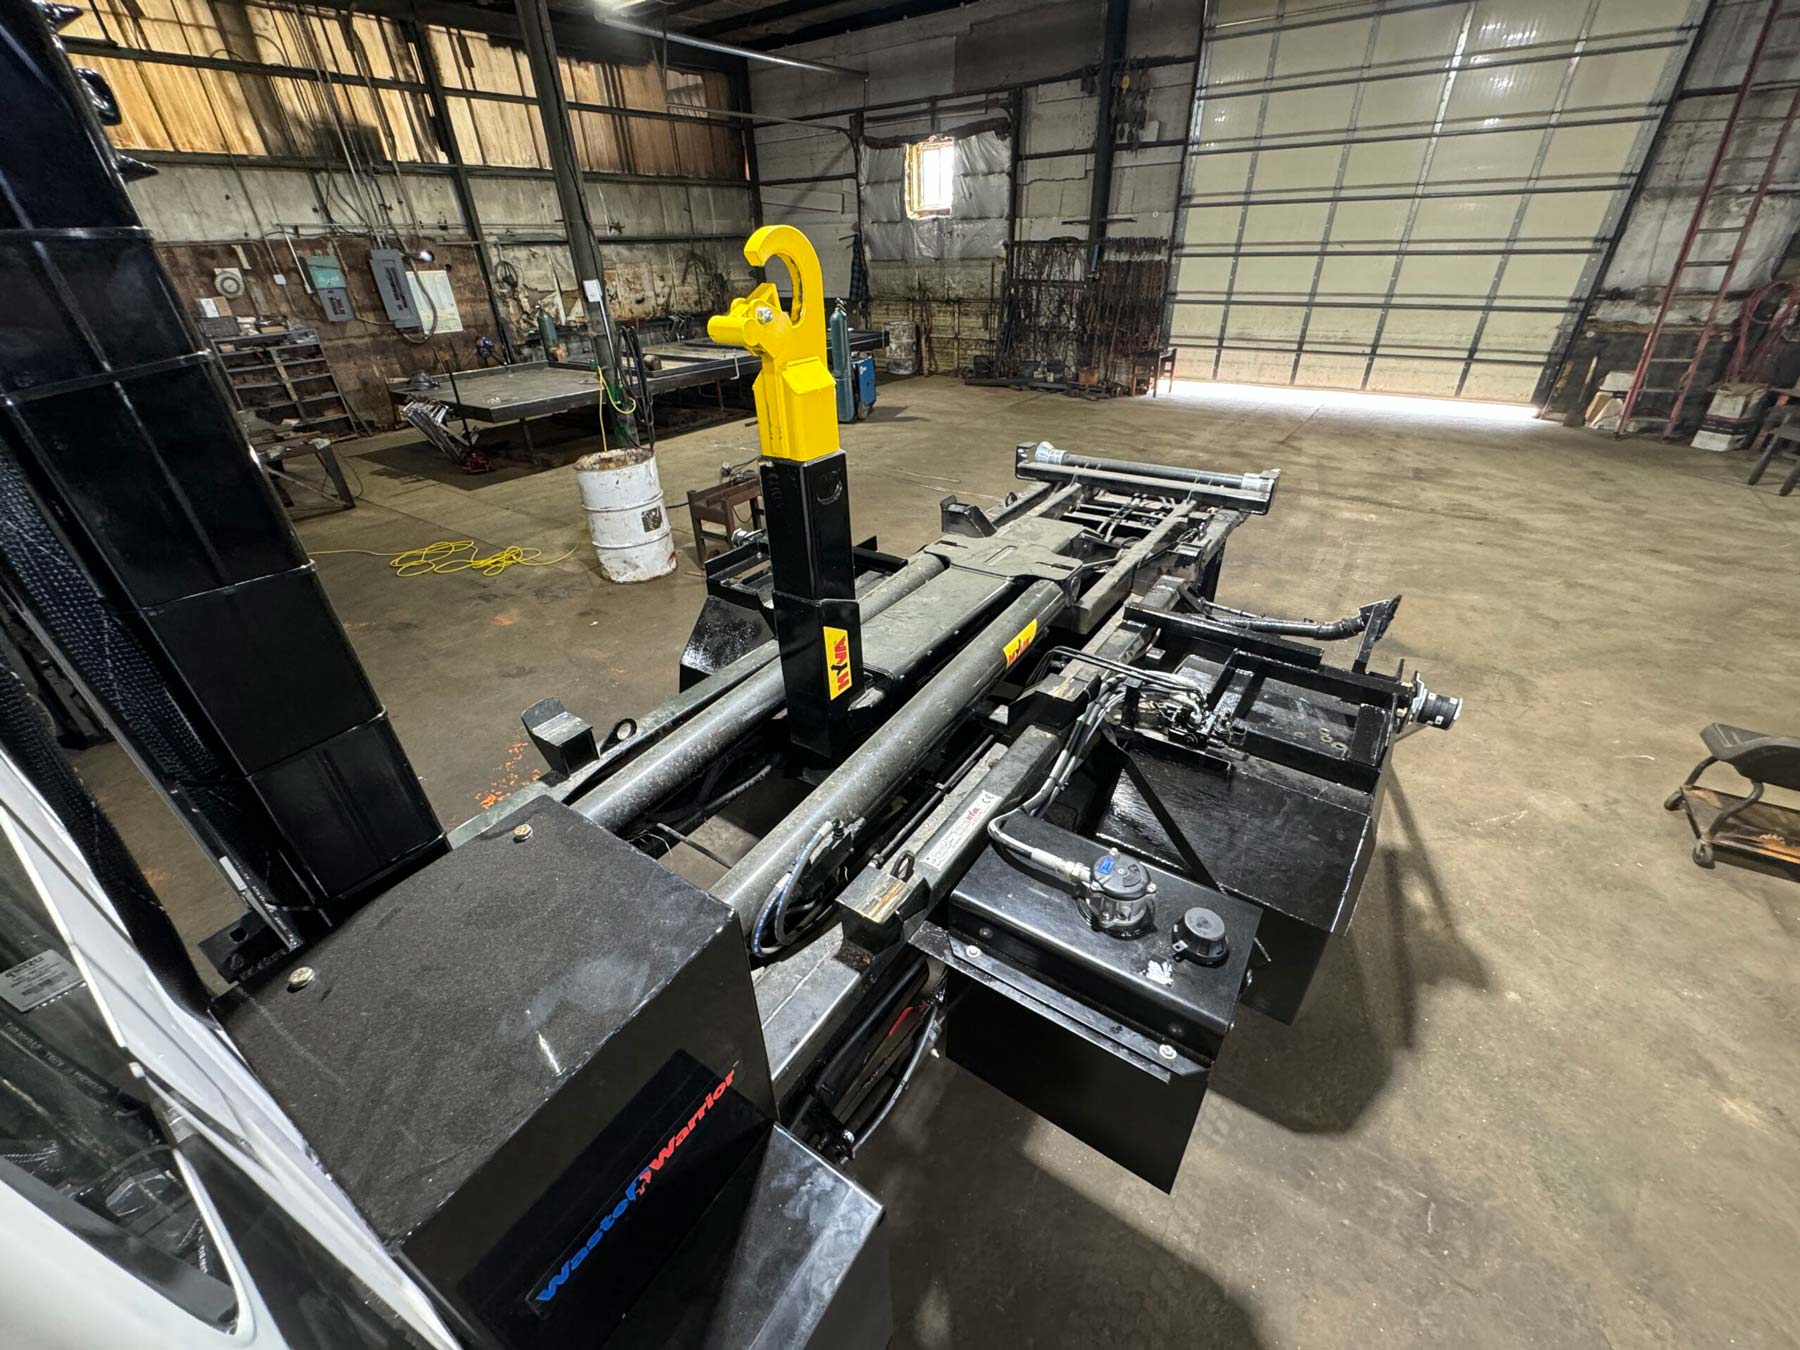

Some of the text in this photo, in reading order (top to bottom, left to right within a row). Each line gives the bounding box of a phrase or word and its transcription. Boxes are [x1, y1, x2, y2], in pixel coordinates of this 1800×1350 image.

[831, 635, 849, 691] HYVA
[537, 1069, 735, 1301] Waste Warrior
